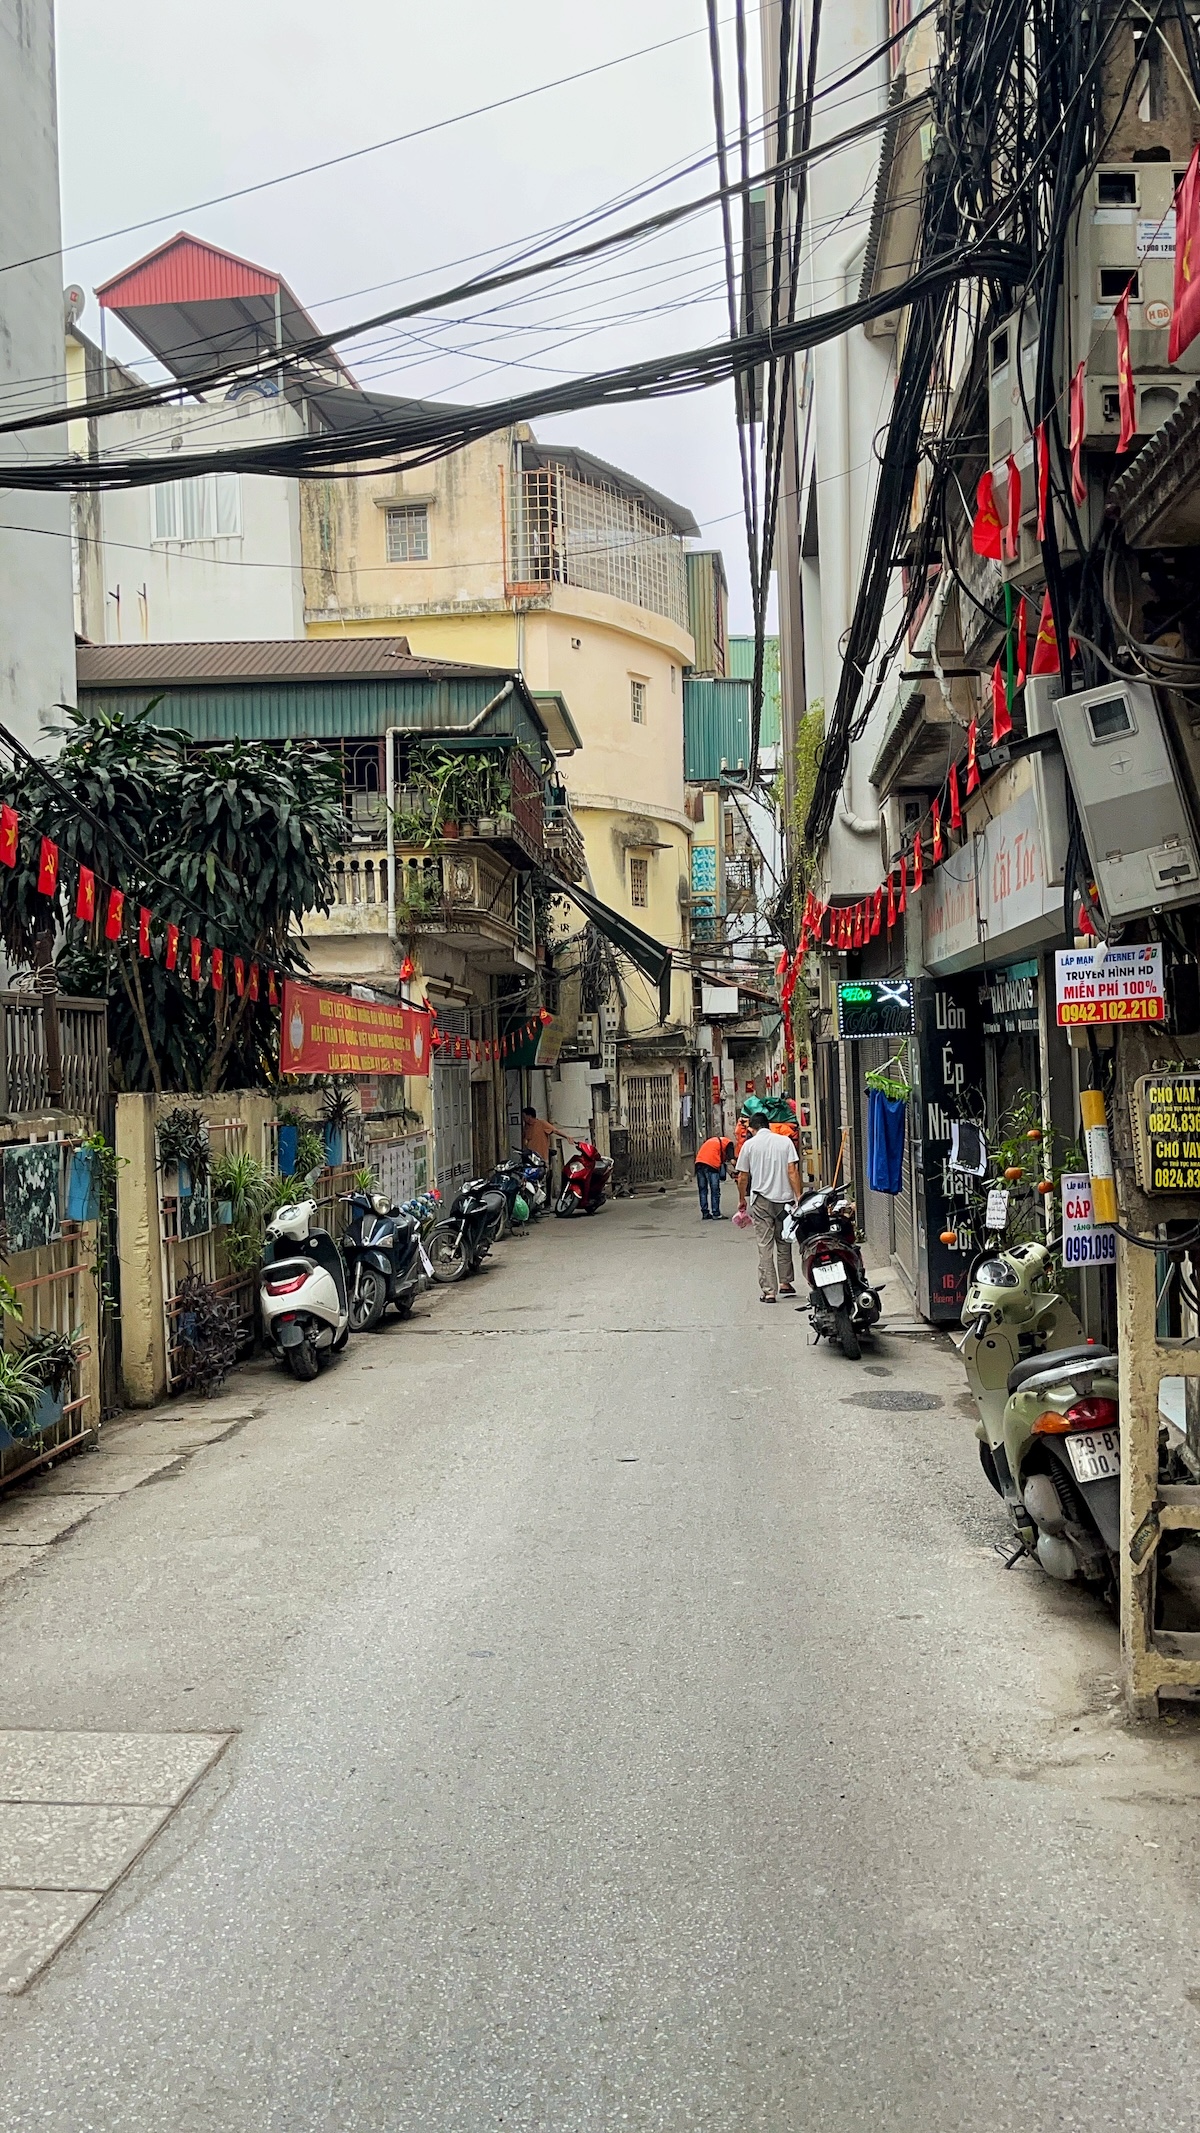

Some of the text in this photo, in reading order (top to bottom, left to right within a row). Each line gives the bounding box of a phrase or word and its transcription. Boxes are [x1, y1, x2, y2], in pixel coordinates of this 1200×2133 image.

[1014, 828, 1035, 891] Tóc
[1076, 955, 1094, 966] MẠN
[1103, 951, 1136, 963] NTERNET
[1108, 965, 1135, 978] HÌNH
[1138, 965, 1154, 975] HD
[1064, 980, 1157, 999] MIỄN PHÍ 100%
[935, 992, 966, 1030] Uốn
[1061, 999, 1158, 1023] 0942.102.216
[942, 1040, 965, 1095] Ép
[1149, 1087, 1173, 1104] CHO
[1149, 1113, 1200, 1133] 0824.836
[1156, 1141, 1180, 1159] CHO
[1155, 1168, 1200, 1188] 0824.83
[1066, 1195, 1091, 1219] CÁP
[1065, 1233, 1116, 1262] 0961.099
